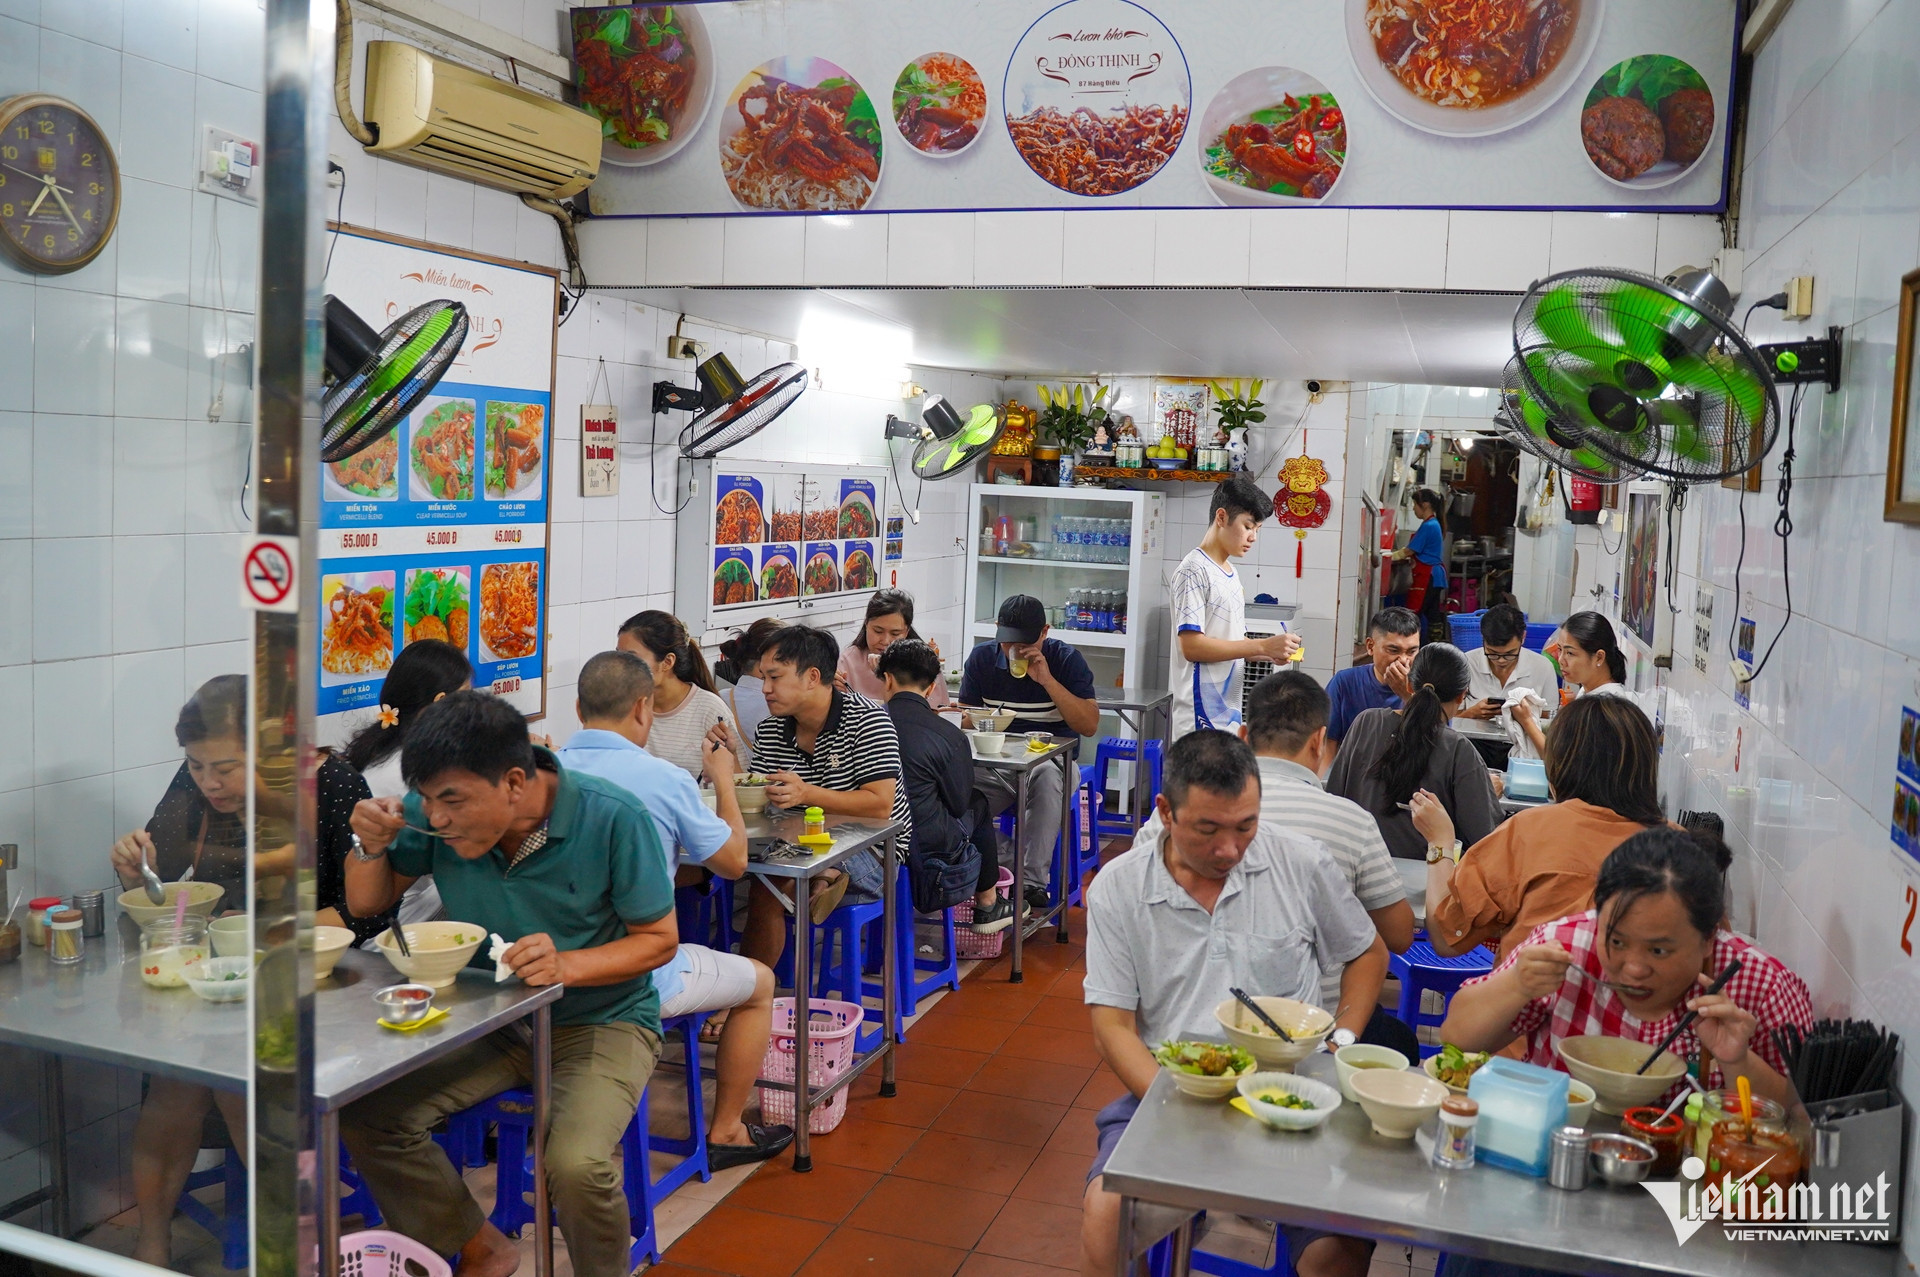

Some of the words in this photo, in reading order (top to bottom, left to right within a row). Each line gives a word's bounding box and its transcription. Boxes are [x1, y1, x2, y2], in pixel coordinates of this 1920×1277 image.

[1096, 54, 1140, 68] THỊNH
[16, 126, 30, 140] 11
[38, 120, 55, 134] 12
[67, 132, 74, 145] 1
[2, 146, 18, 160] 10
[82, 154, 92, 167] 2
[89, 182, 99, 195] 3
[3, 203, 14, 217] 8
[82, 208, 93, 221] 4
[20, 225, 32, 238] 7
[67, 229, 78, 241] 5
[44, 235, 55, 248] 6
[424, 268, 448, 286] Miến
[343, 533, 370, 548] 55.000
[427, 532, 450, 545] 45.000
[495, 530, 515, 542] 45.000
[494, 680, 514, 695] 35.000
[1735, 726, 1742, 772] 3
[1901, 884, 1918, 958] 2
